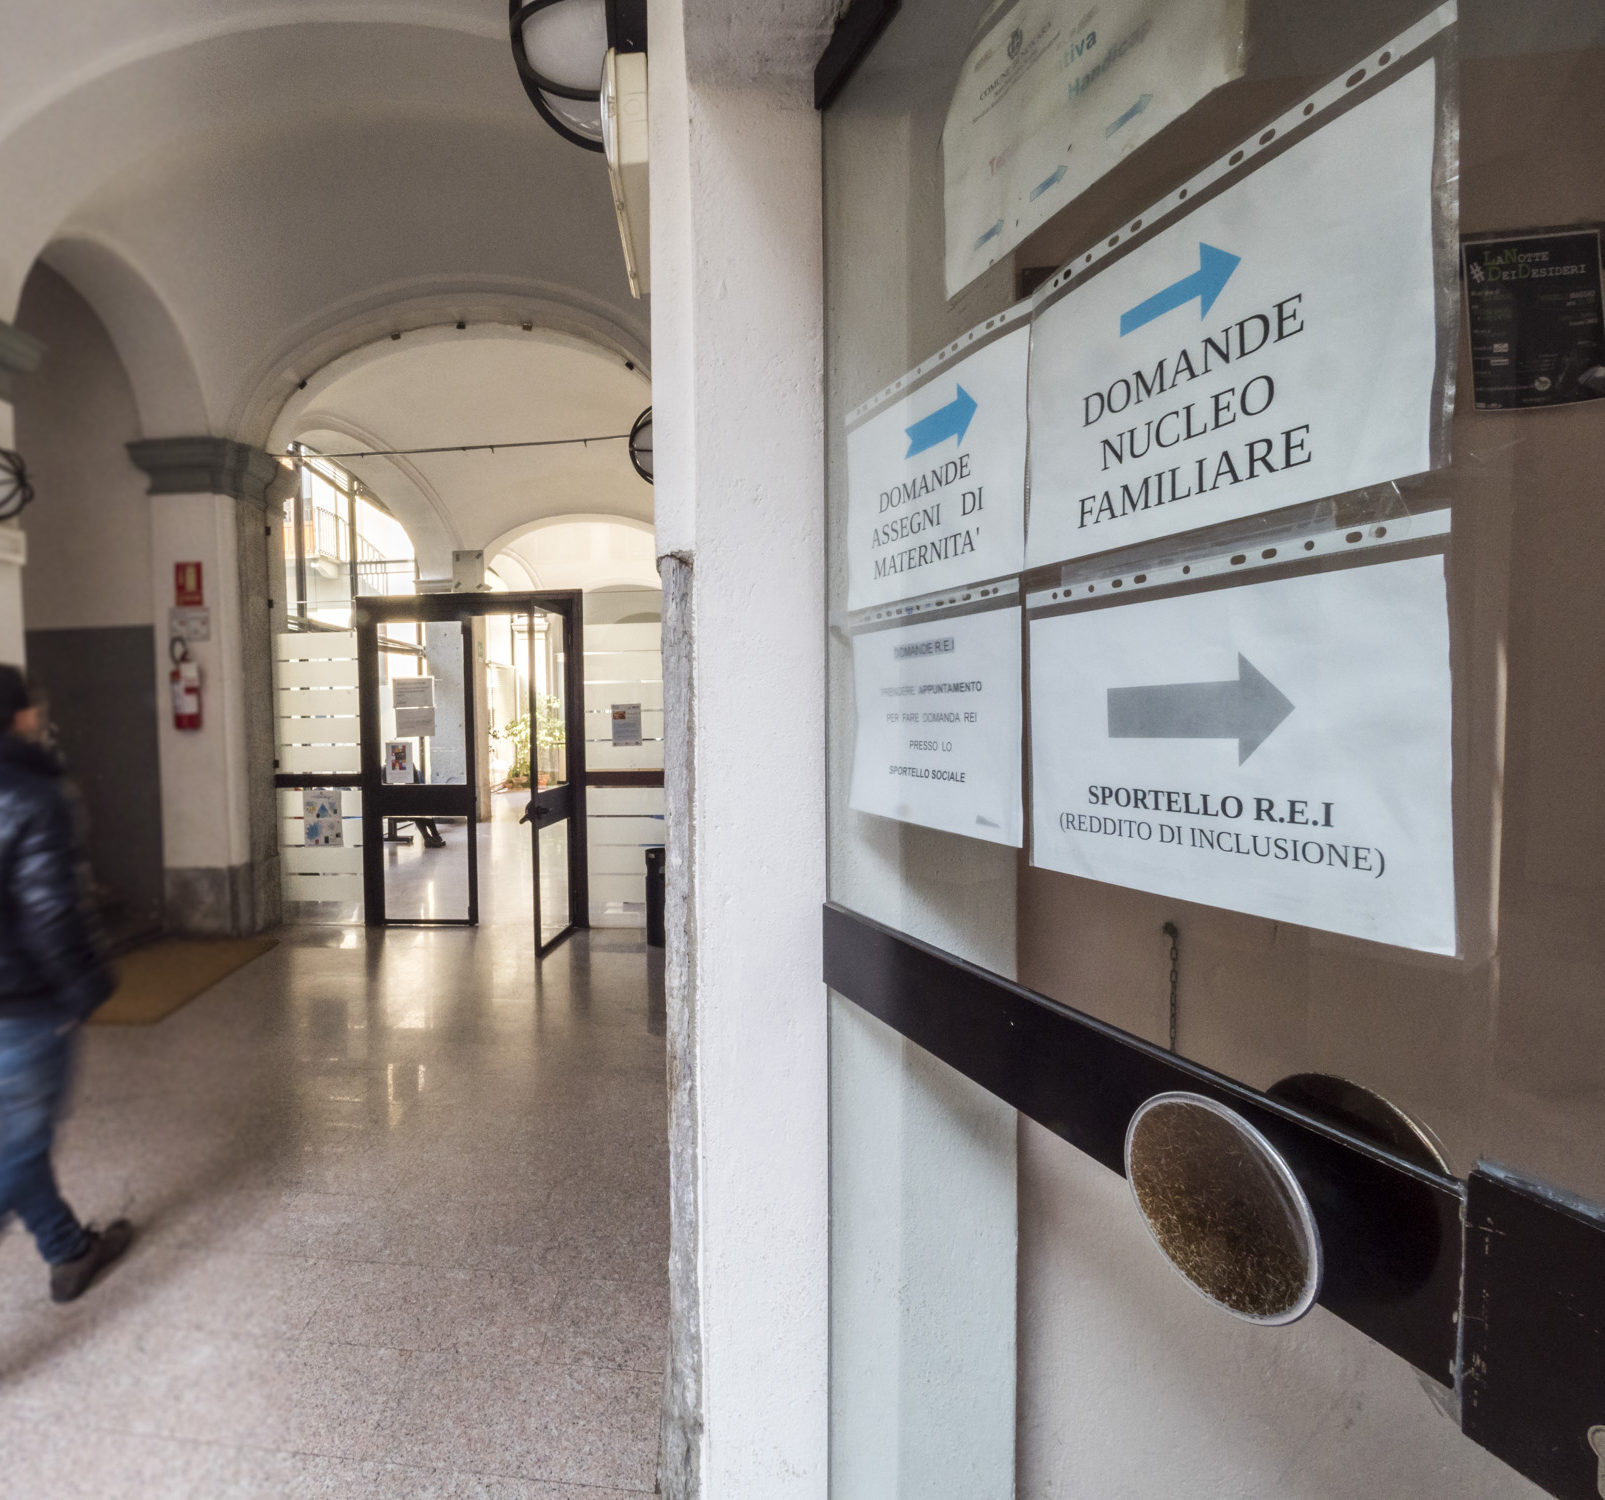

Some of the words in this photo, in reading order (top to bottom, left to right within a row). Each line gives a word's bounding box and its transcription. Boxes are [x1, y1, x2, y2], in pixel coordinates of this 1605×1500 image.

[1082, 292, 1305, 428] DOMANDE
[1100, 374, 1275, 472] NUCLEO
[878, 453, 971, 514] DOMANDE
[1077, 424, 1312, 529] FAMILIARE
[871, 503, 942, 550] ASSEGNI
[960, 486, 984, 517] DI
[873, 527, 980, 580] MATERNITA'
[918, 680, 982, 695] APPUNTAMENTO
[886, 713, 900, 723] PER
[902, 713, 919, 723] FARE
[922, 712, 960, 723] DOMANDA
[964, 711, 977, 723] REI
[909, 739, 938, 751] PRESSO
[941, 740, 952, 752] LO
[889, 765, 930, 779] SPORTELLO
[931, 768, 965, 783] SOCIALE
[1088, 785, 1244, 819] SPORTELLO
[1253, 797, 1335, 828] R.E.I
[1059, 812, 1152, 841] (REDDITO
[1159, 823, 1183, 845] DI
[1190, 827, 1386, 879] INCLUSIONE)
